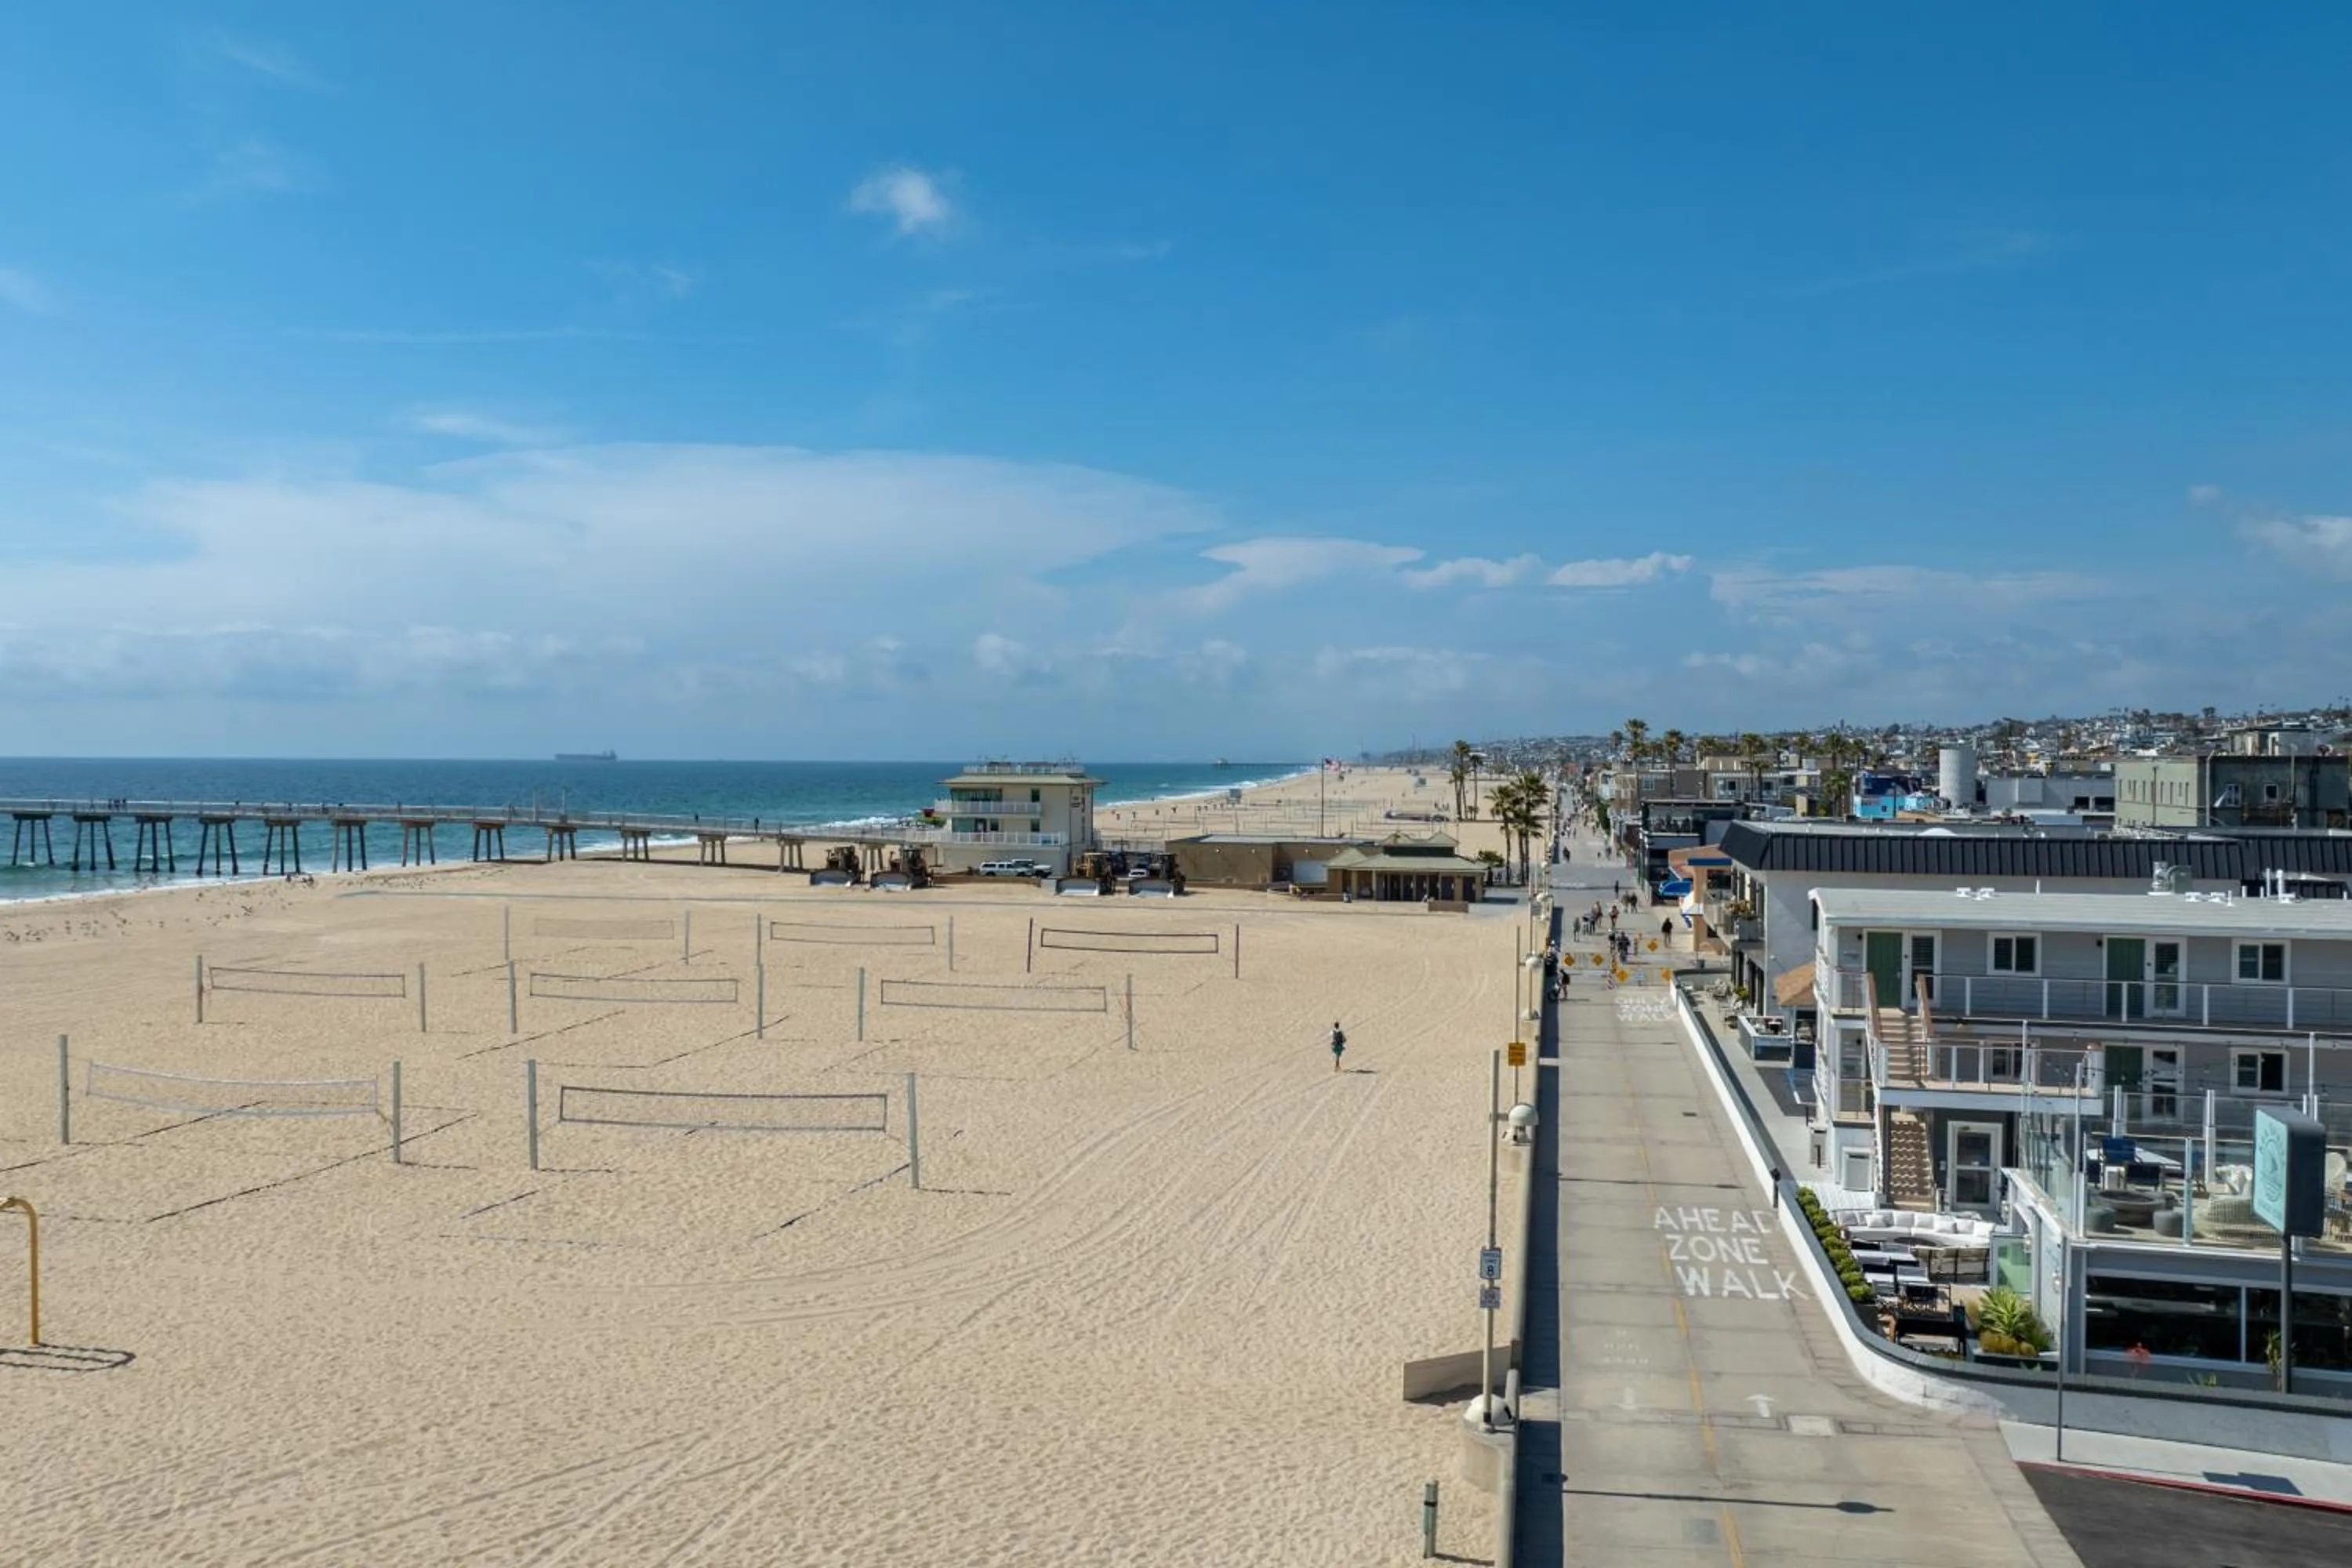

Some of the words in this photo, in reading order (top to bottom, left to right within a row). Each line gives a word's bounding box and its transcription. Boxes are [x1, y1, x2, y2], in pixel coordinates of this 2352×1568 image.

[1653, 1206, 1774, 1234] AHEAD
[1665, 1233, 1769, 1265] ZONE
[1676, 1265, 1809, 1300] WALK
